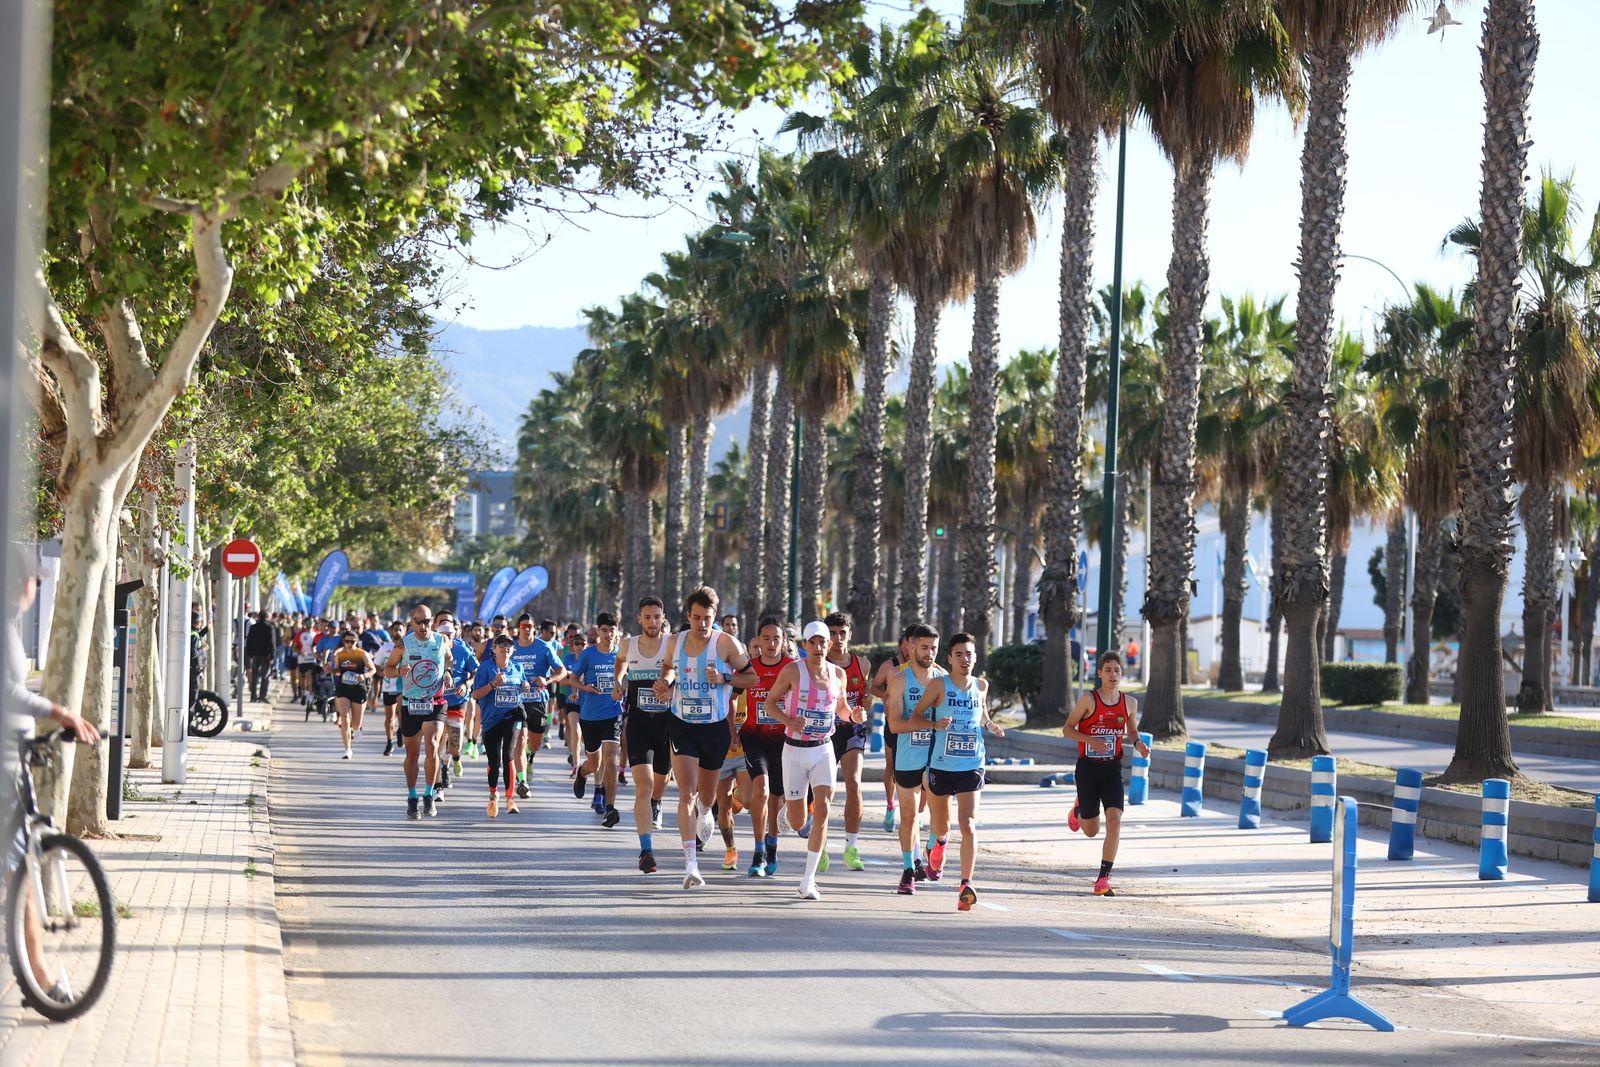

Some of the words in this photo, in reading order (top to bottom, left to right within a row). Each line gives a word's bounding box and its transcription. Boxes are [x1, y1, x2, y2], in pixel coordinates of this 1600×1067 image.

[500, 575, 540, 614] mayoral
[948, 696, 979, 710] nerja
[812, 719, 825, 727] 25
[950, 741, 974, 750] 2156
